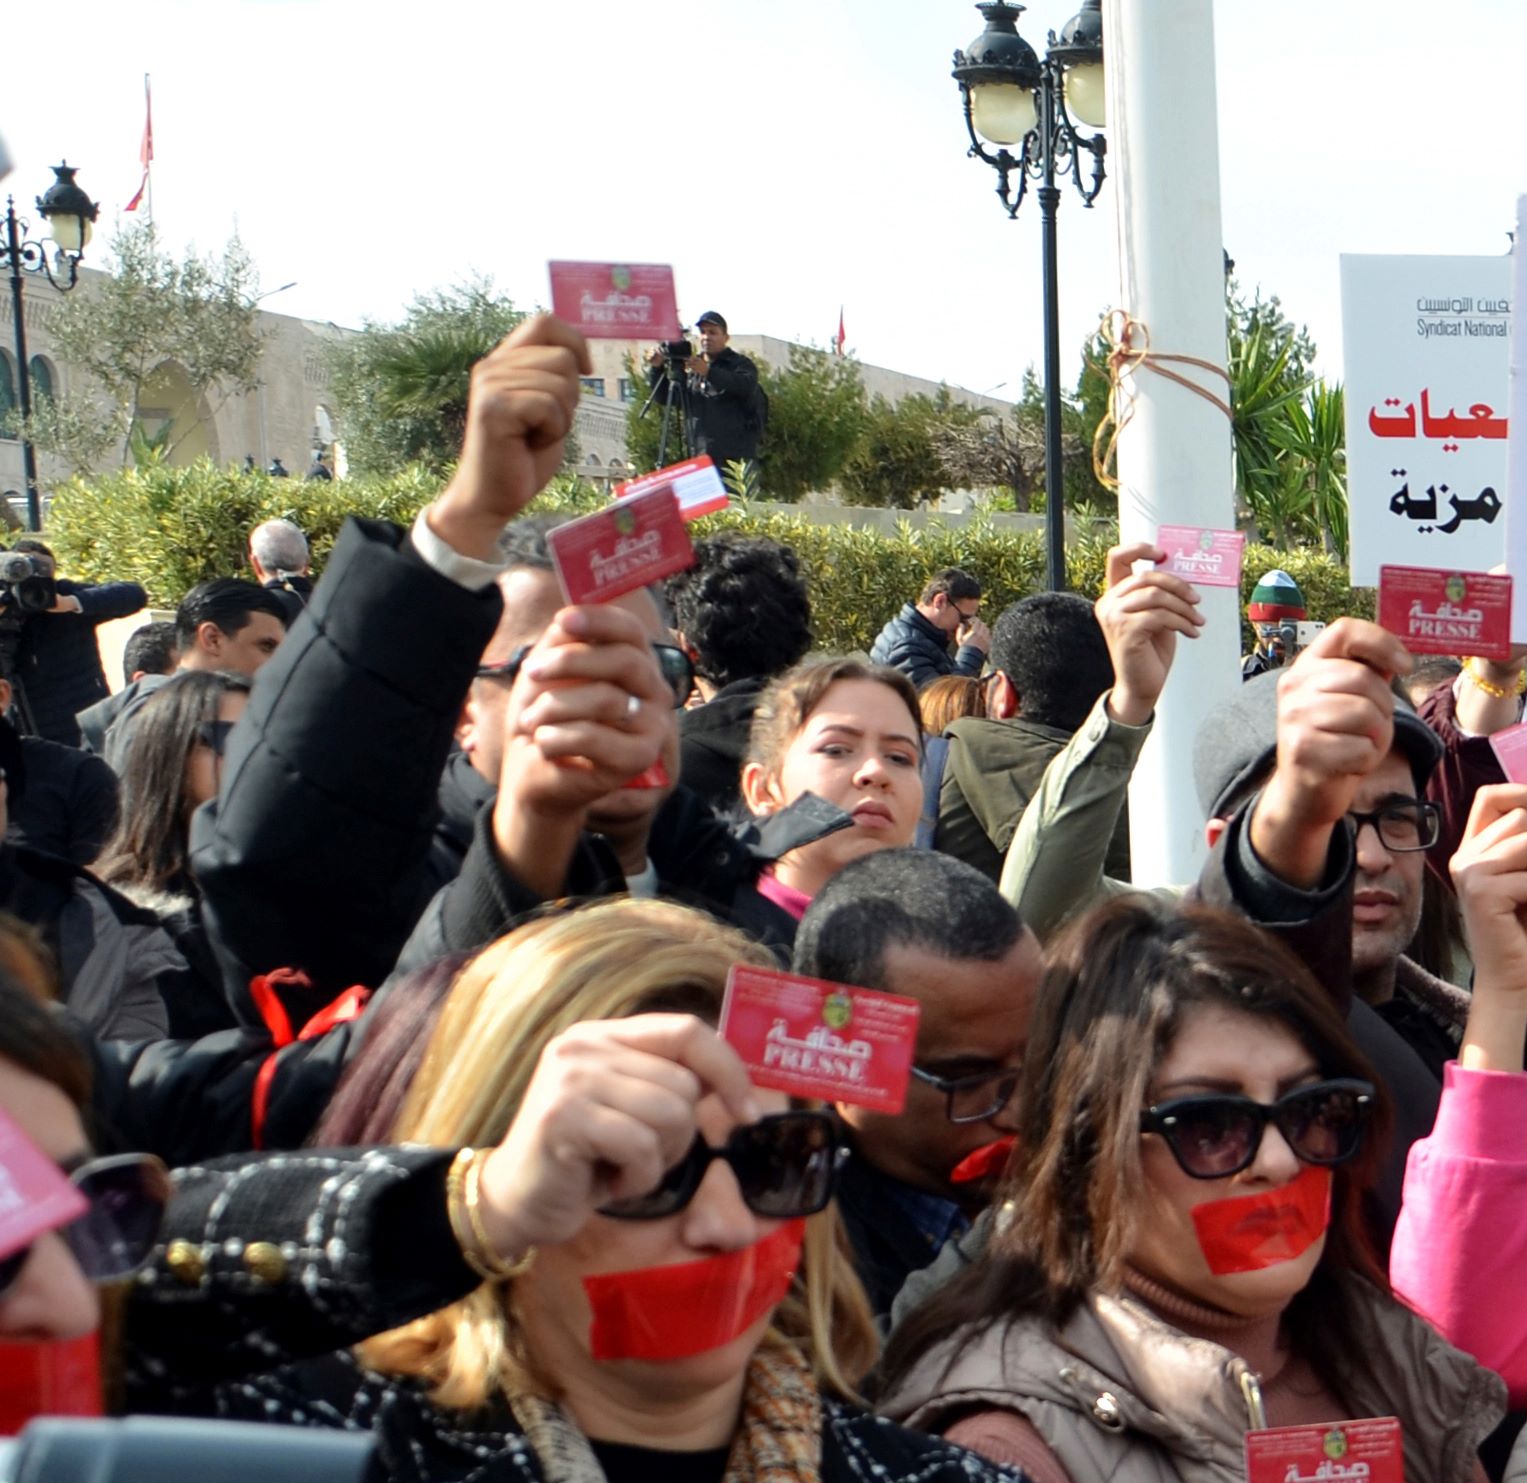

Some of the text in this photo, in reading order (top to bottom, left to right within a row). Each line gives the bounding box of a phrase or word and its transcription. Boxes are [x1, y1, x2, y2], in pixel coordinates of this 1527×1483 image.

[1416, 318, 1508, 339] Syndicat National
[1368, 387, 1508, 452] عيات
[1389, 468, 1503, 534] مزية
[1408, 619, 1482, 639] PRESSE
[764, 1042, 868, 1082] PRESSE
[1284, 1460, 1371, 1483] صحافة
